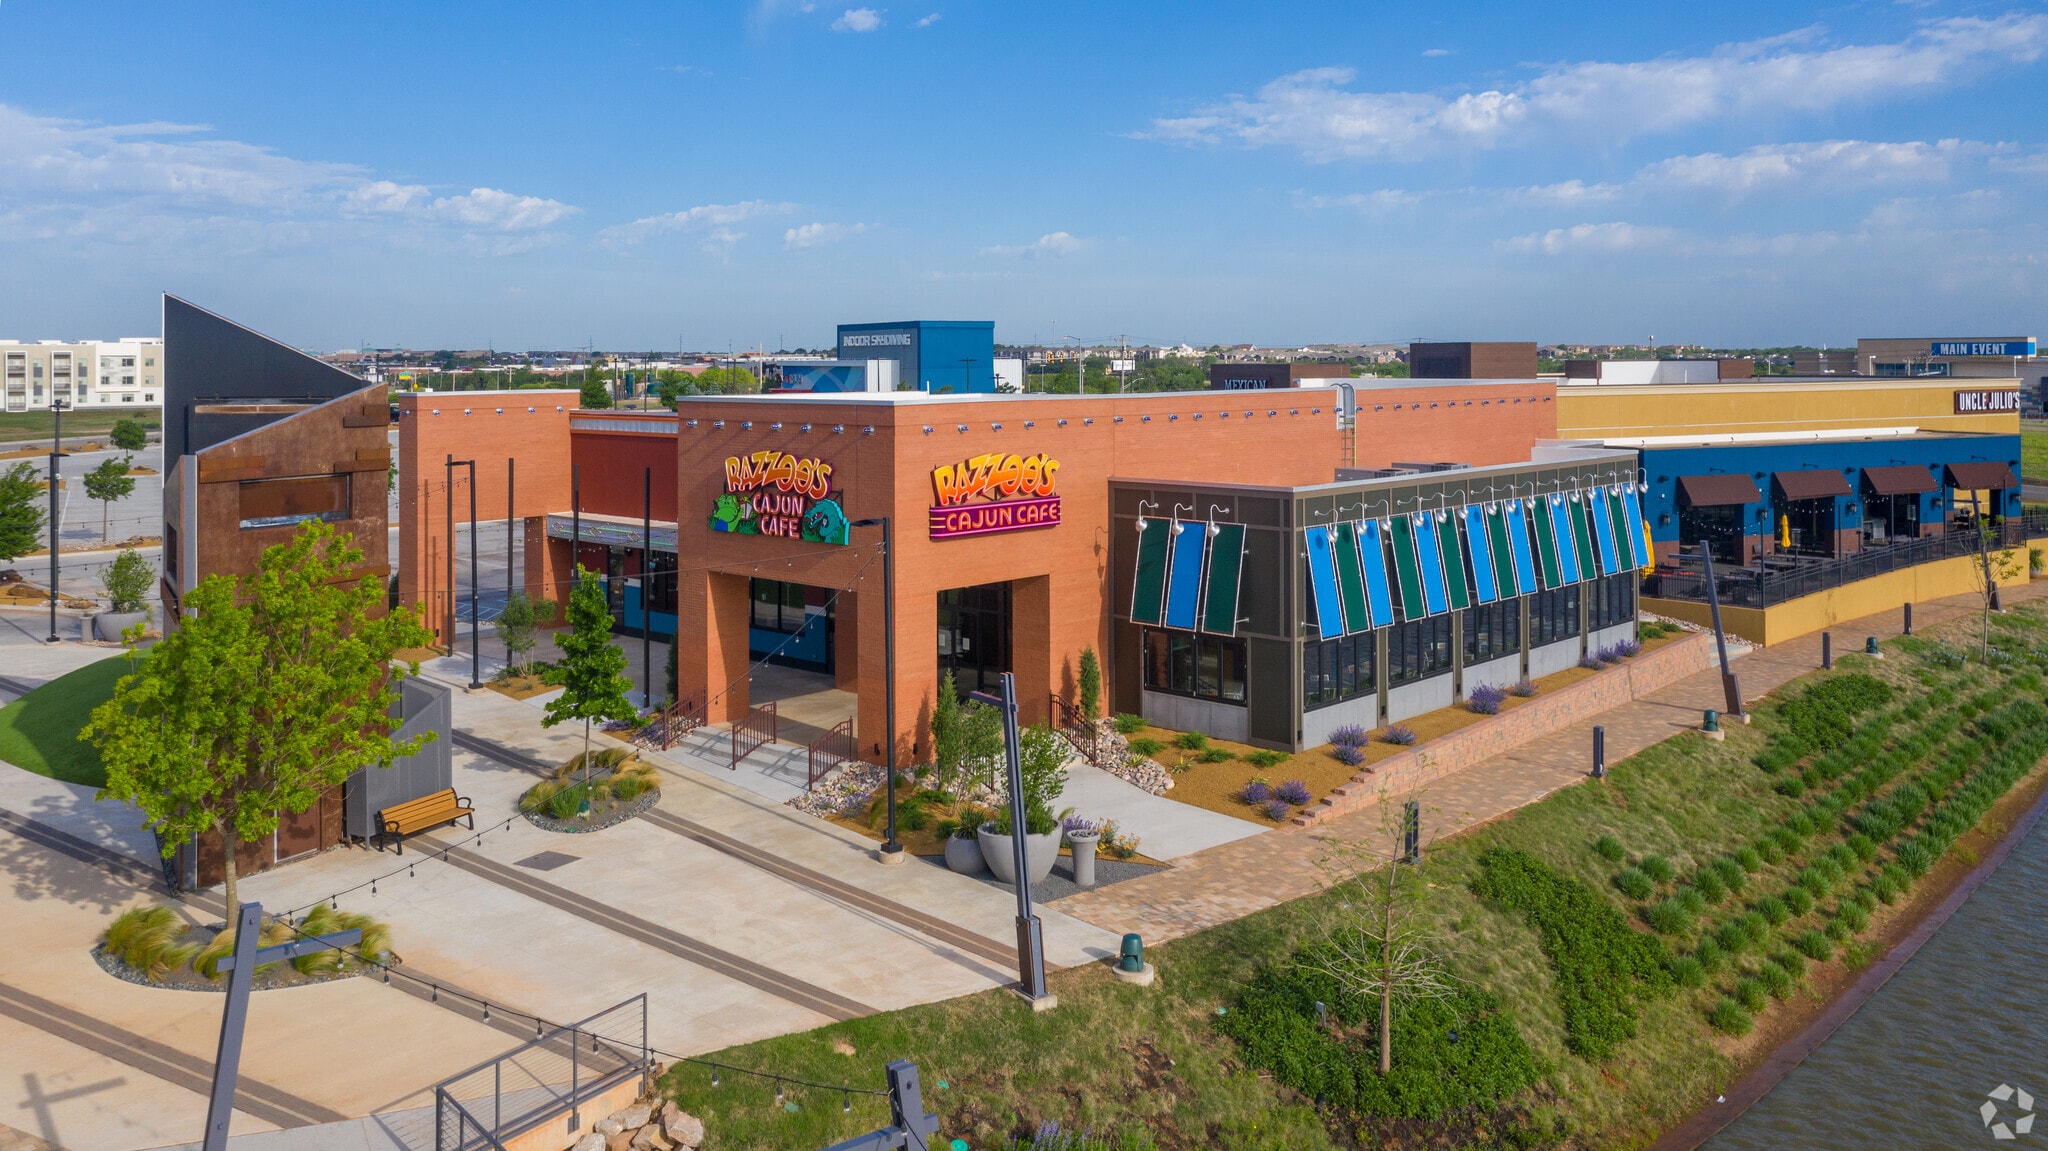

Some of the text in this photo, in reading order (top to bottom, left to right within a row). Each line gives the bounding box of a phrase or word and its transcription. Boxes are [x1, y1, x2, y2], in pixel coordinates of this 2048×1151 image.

[843, 334, 911, 347] INDOOR SKYDIVING
[1940, 343, 2006, 355] MAIN EVENT
[1224, 379, 1267, 390] MEXICAN
[1960, 391, 2020, 411] UNCLE JULIO'S
[725, 450, 832, 500] RAZZOO'S
[934, 452, 1060, 506] RAZZOO'S
[752, 492, 805, 517] CAJUN
[761, 514, 800, 539] CAFE
[945, 503, 1058, 532] CAJUN CAFE
